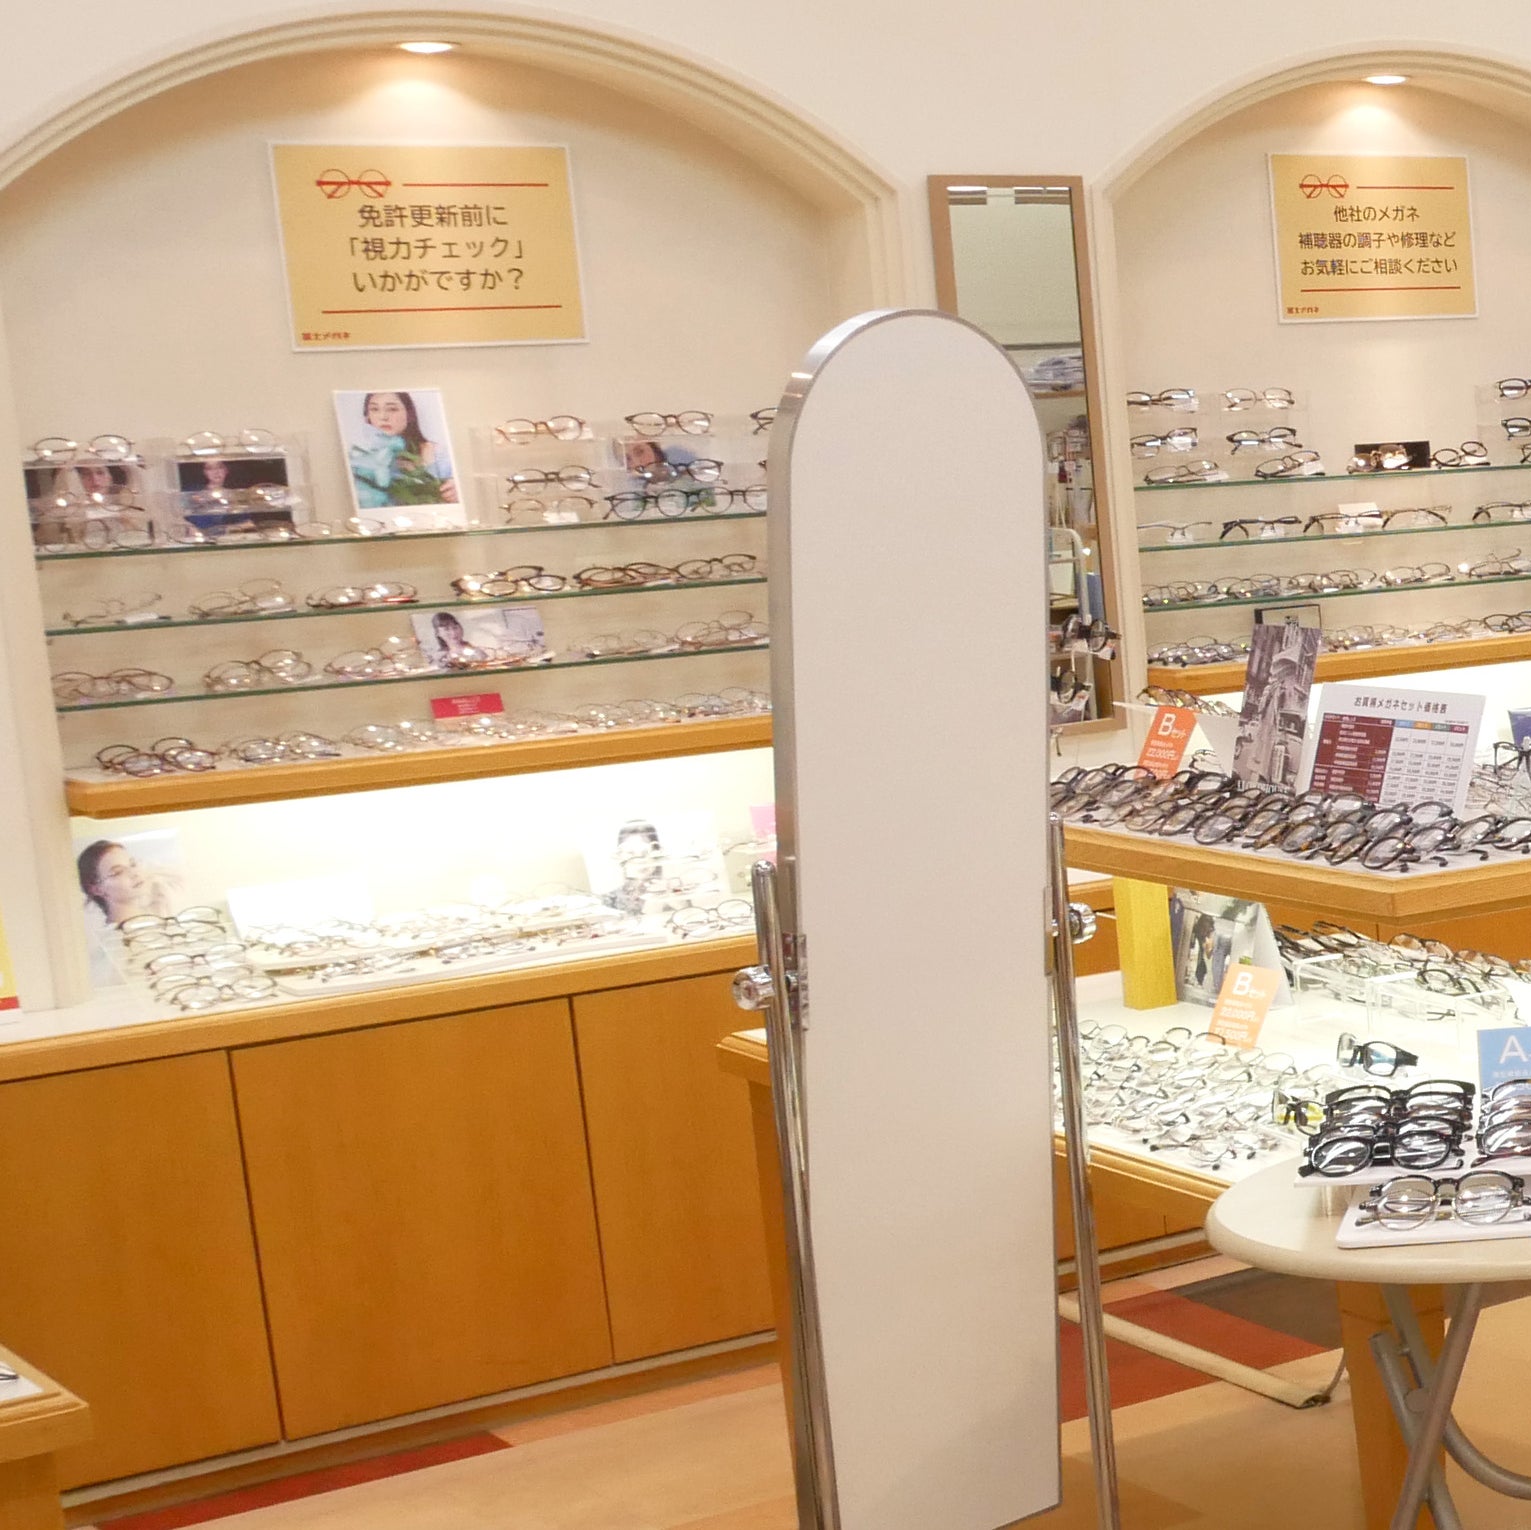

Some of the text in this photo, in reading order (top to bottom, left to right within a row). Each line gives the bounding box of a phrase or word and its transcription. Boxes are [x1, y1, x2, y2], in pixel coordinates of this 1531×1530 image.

[358, 204, 509, 228] 免許更新前に
[1334, 205, 1421, 222] 他社のメガネ
[350, 236, 524, 261] 「視力チェック」
[1299, 232, 1457, 249] 補聴器の調子や修理など
[1301, 258, 1458, 276] お気軽にご相談ください
[353, 268, 524, 293] いかがですか？
